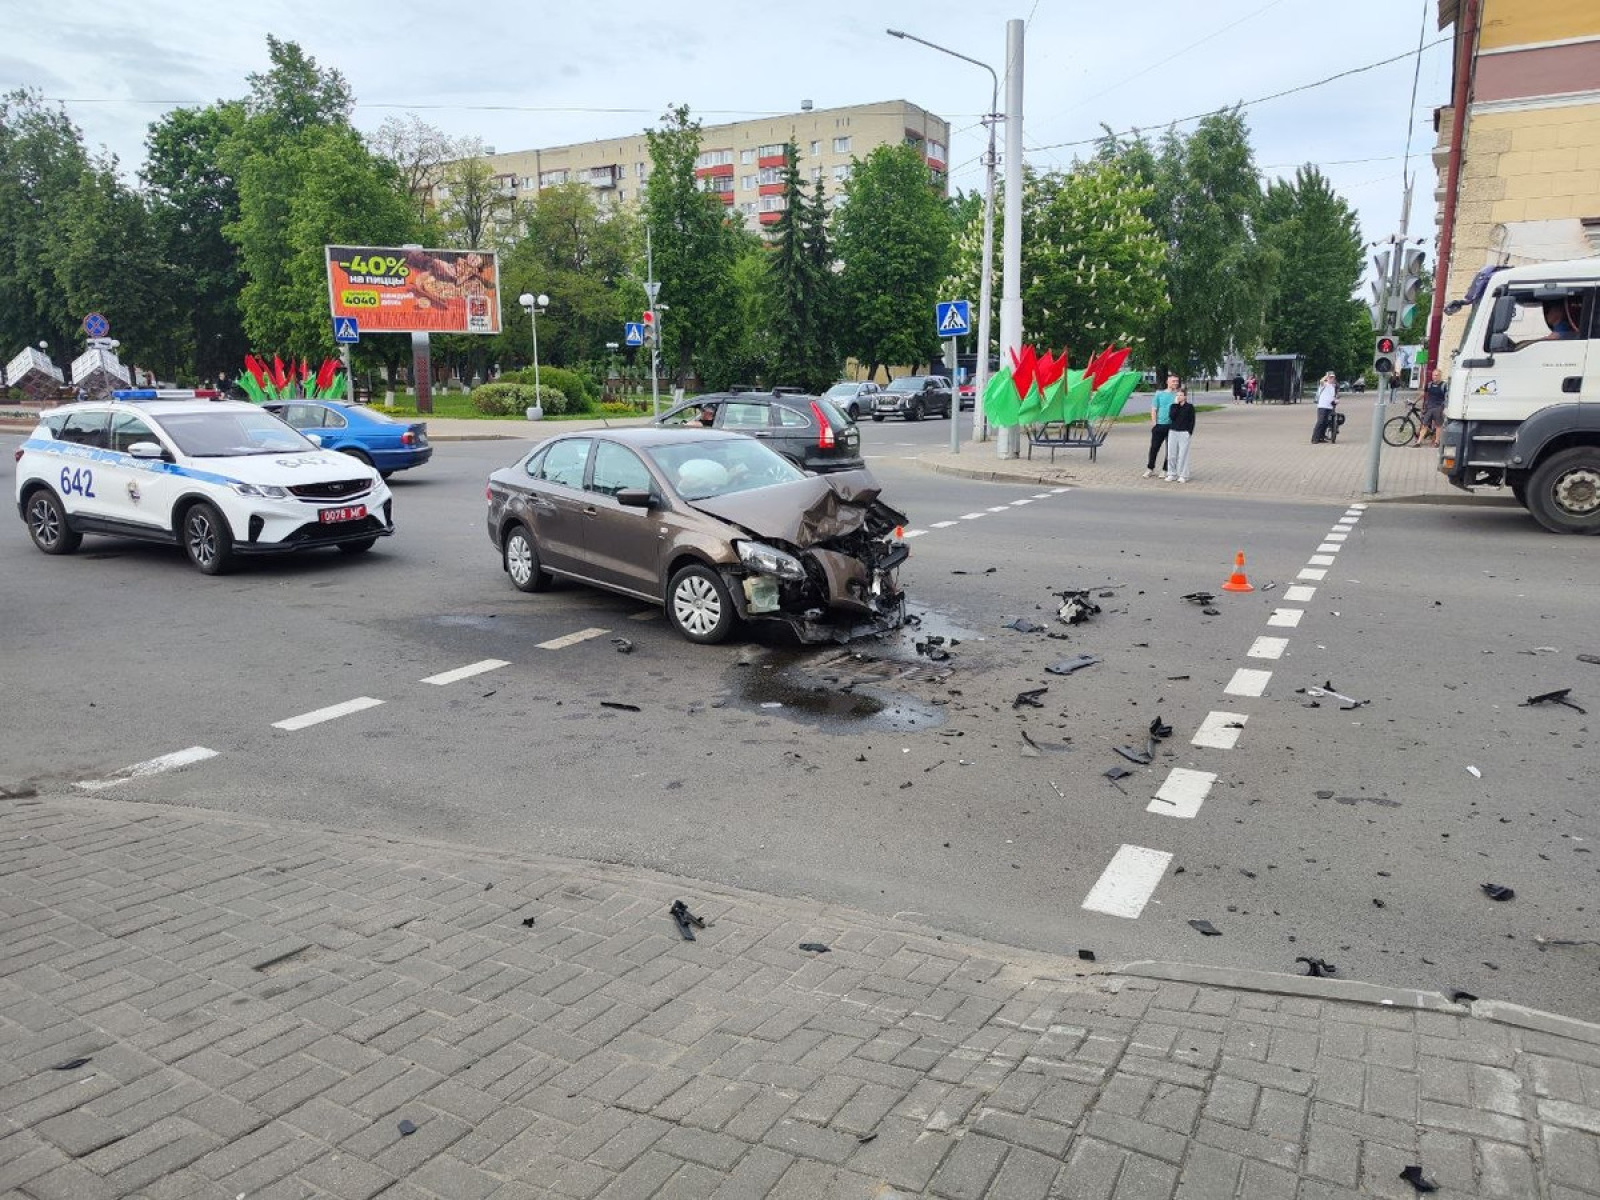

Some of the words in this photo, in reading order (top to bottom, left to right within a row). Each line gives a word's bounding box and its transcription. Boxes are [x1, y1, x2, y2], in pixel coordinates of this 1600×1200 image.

[339, 255, 410, 277] -40%
[350, 275, 365, 284] на
[366, 276, 405, 287] пиццы
[345, 296, 377, 305] 4040
[60, 466, 95, 498] 642
